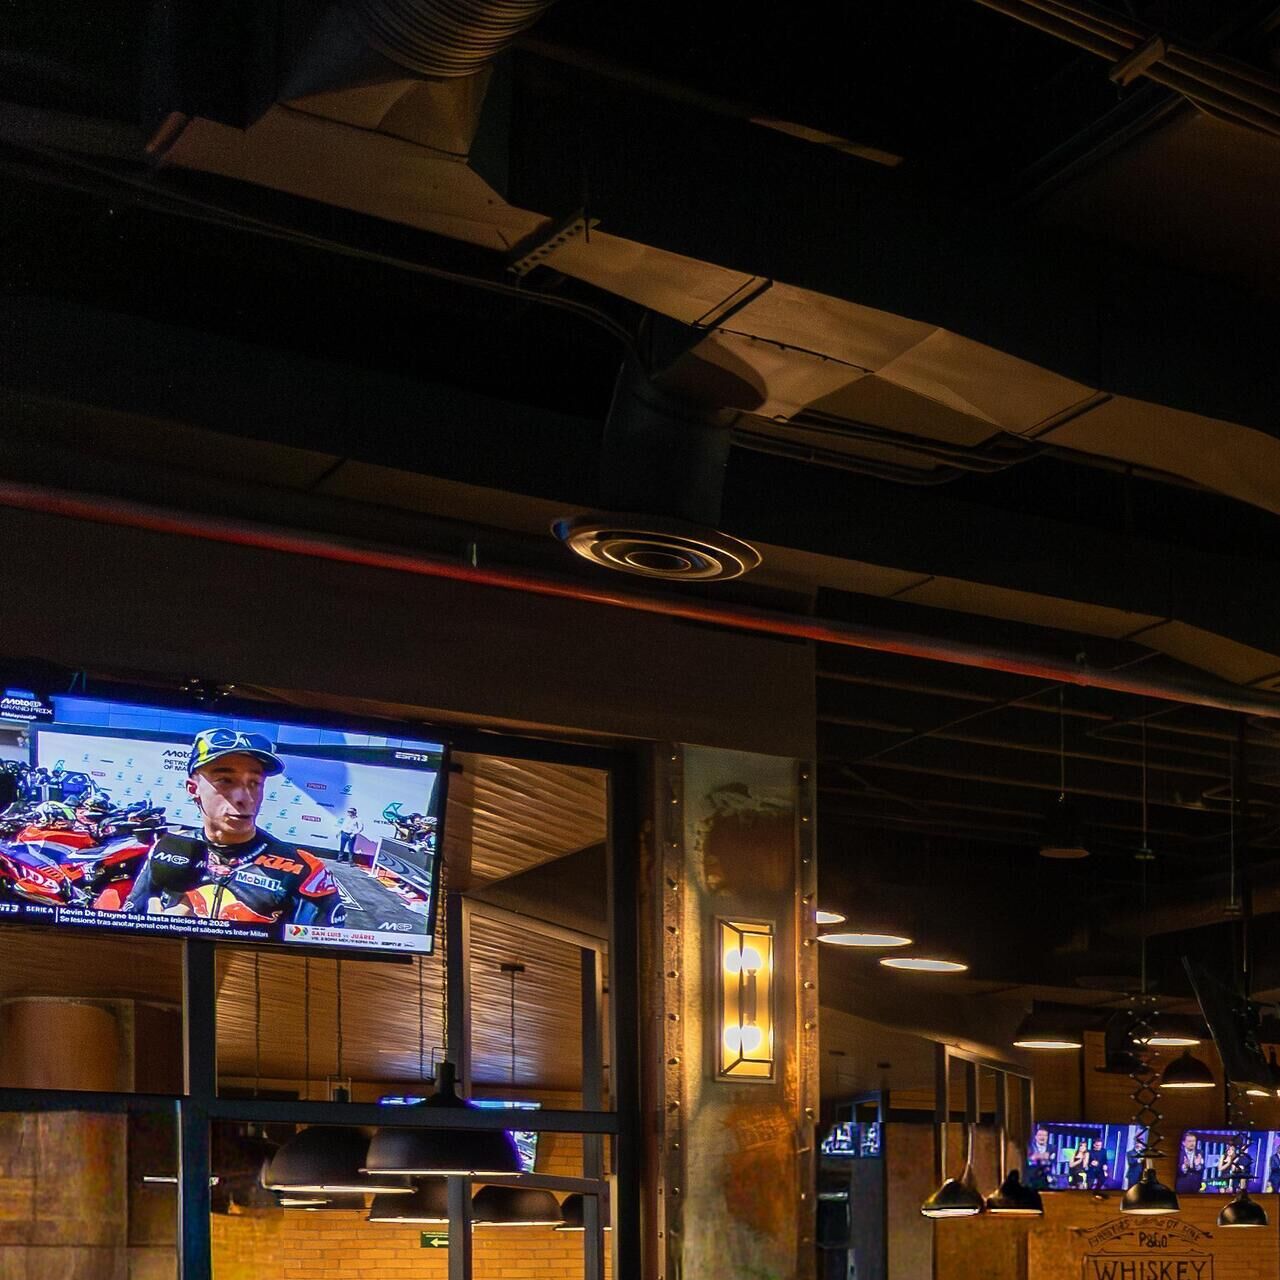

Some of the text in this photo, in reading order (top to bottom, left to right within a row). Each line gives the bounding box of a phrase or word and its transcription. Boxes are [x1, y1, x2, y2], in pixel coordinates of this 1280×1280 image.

[254, 854, 304, 875] KTM
[237, 872, 267, 887] Mobil
[60, 907, 83, 916] Kevin
[85, 909, 96, 917] De
[98, 910, 126, 920] Bruyne
[128, 912, 145, 921] baja
[146, 914, 169, 922] hasta
[170, 917, 196, 925] inicios
[209, 919, 230, 927] 2026
[70, 916, 96, 924] lesionó
[97, 918, 111, 926] tras
[112, 920, 134, 928] anotar
[136, 921, 155, 930] penal
[170, 924, 191, 934] Napoli
[250, 930, 269, 938] Milan
